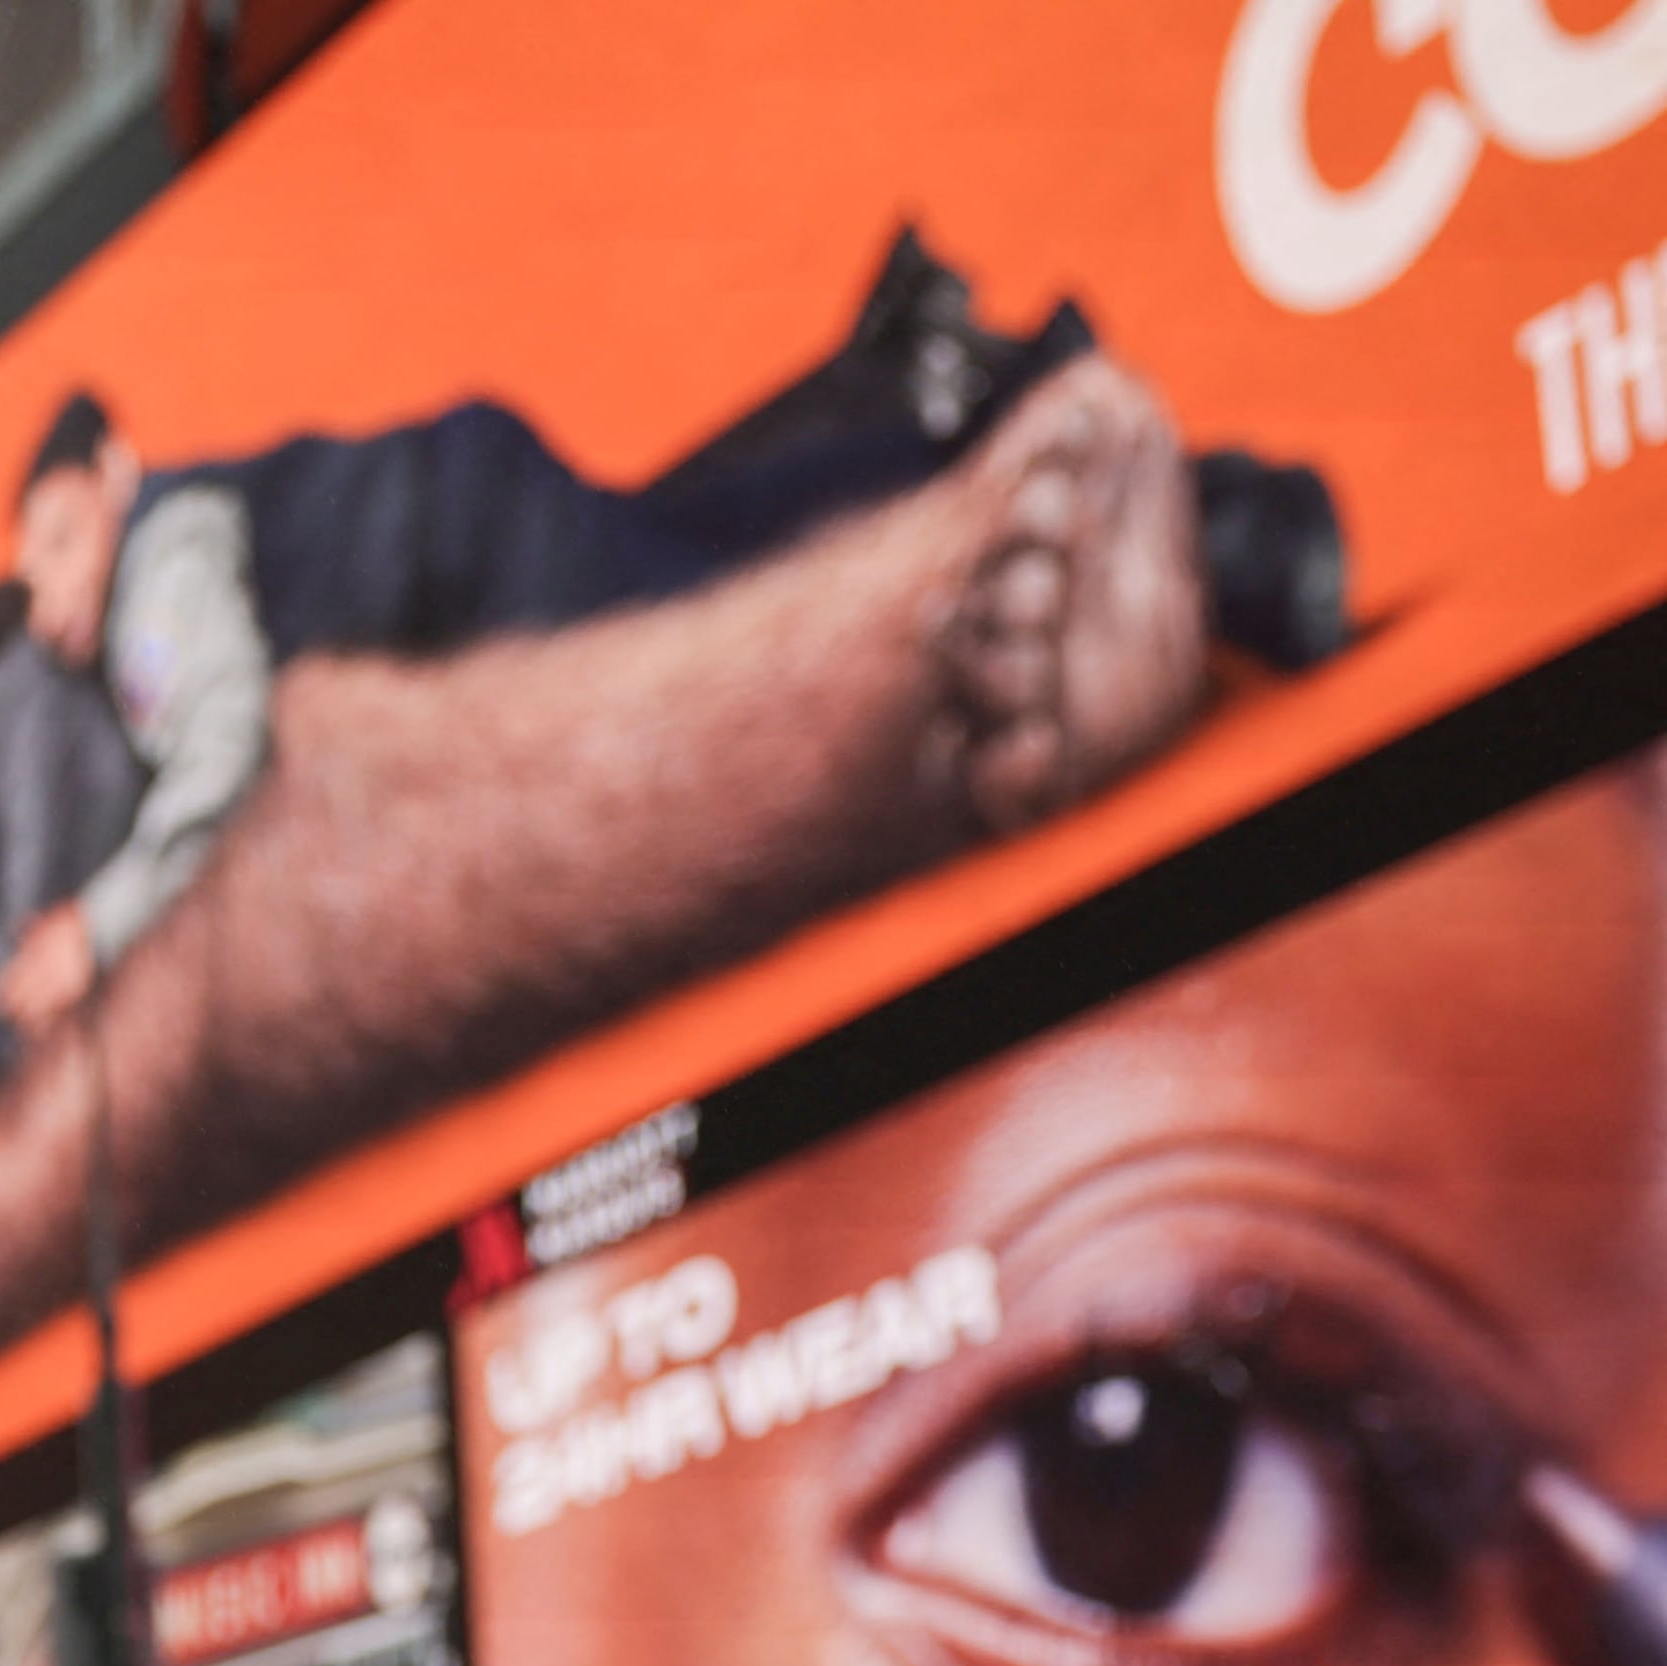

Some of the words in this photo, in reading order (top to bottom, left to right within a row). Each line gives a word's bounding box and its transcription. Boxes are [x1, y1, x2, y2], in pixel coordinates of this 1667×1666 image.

[486, 1306, 608, 1434] UP
[609, 1255, 737, 1381] TO
[494, 1366, 723, 1536] 24HR
[718, 1245, 1000, 1436] WEAR
